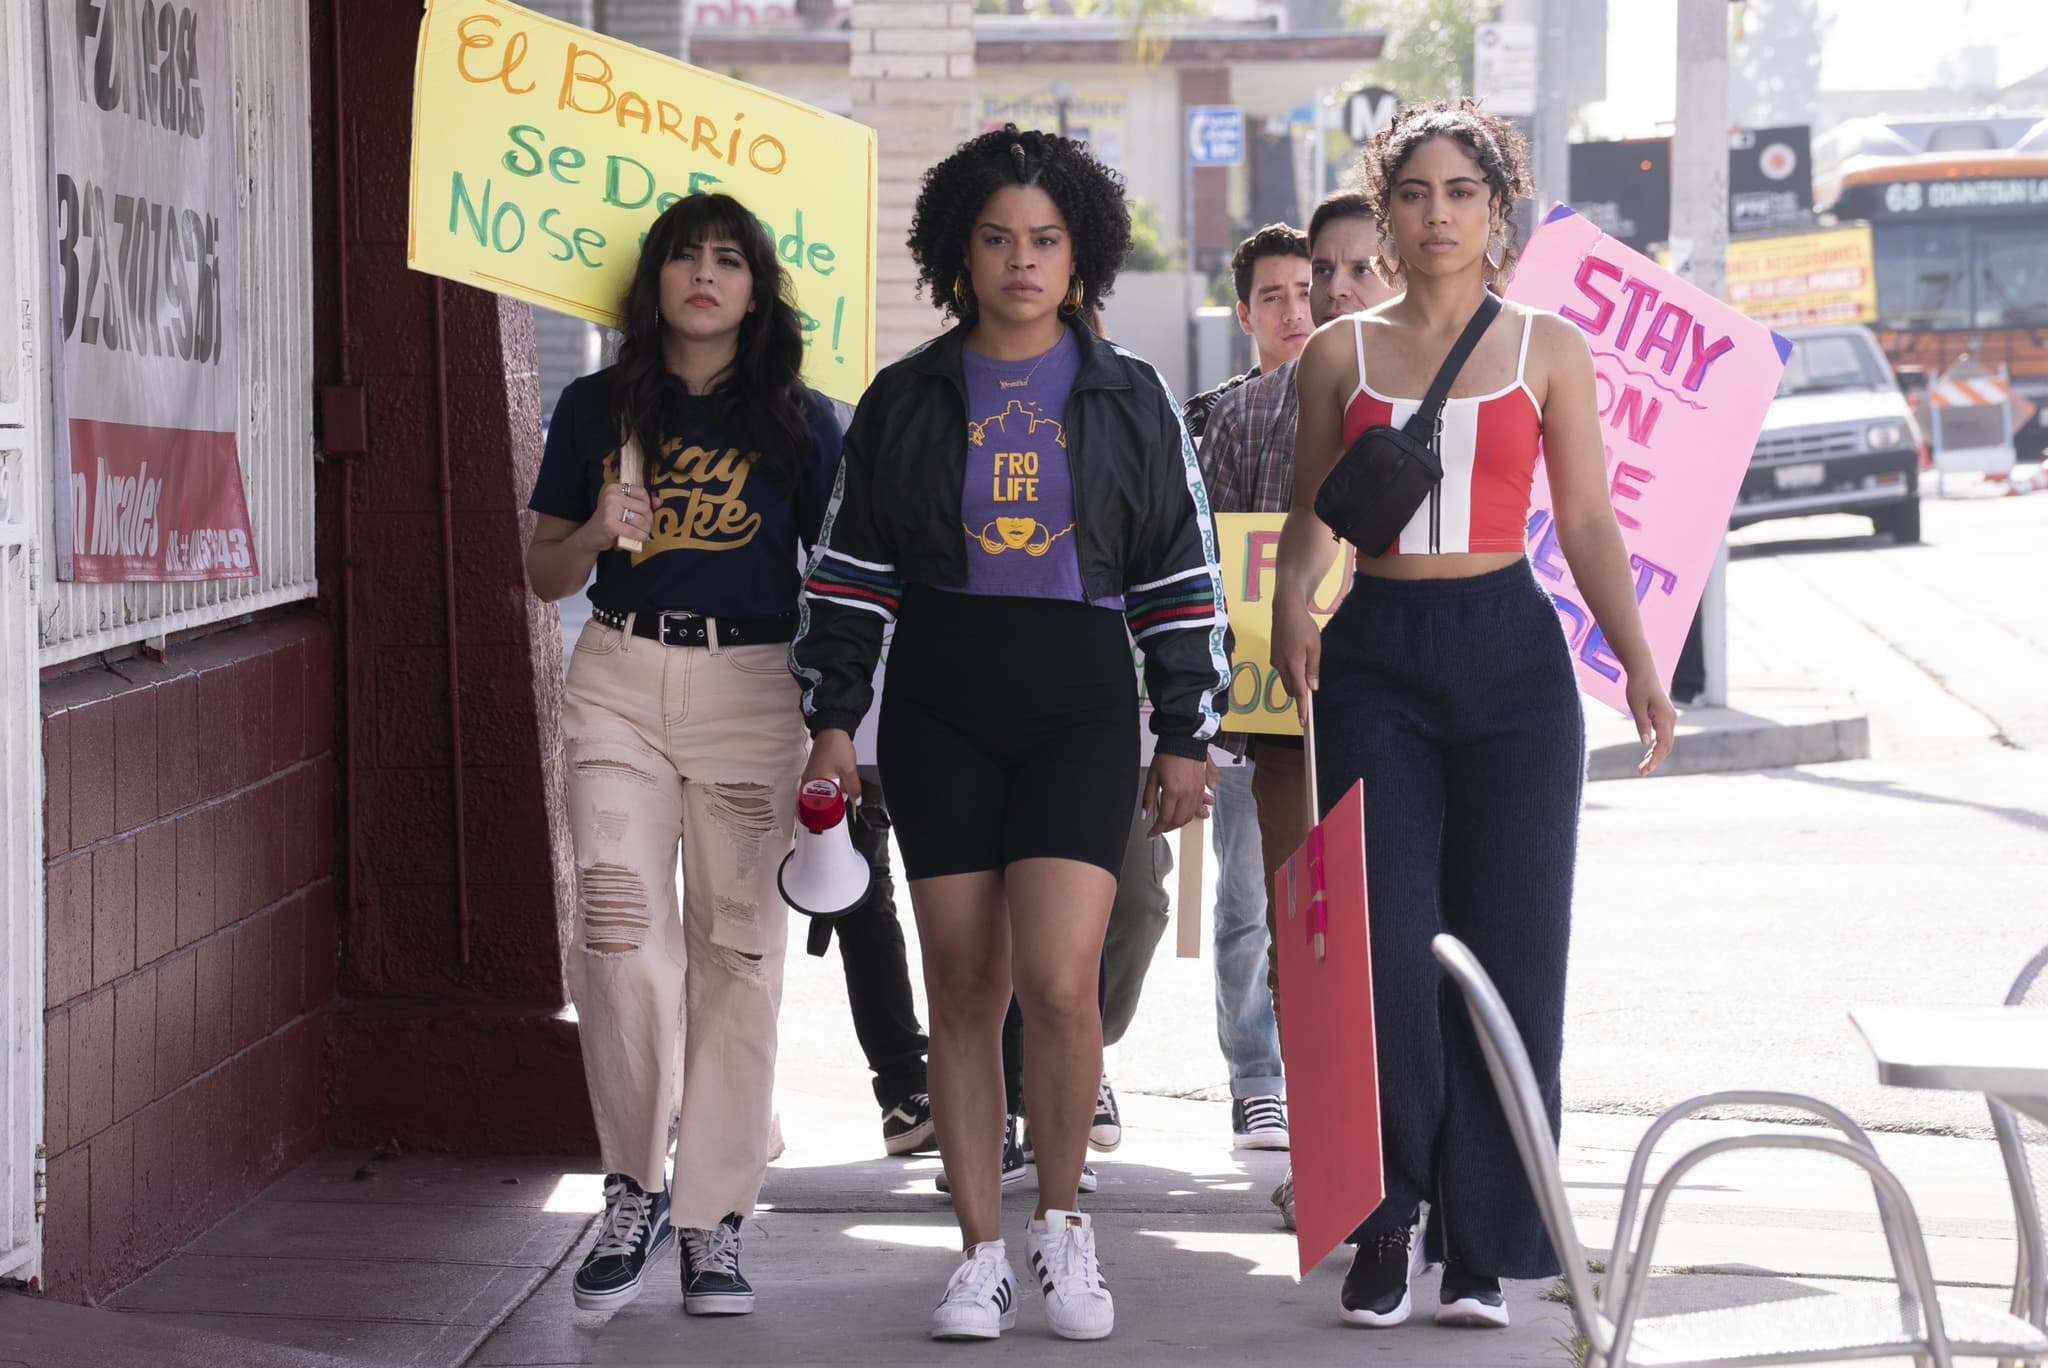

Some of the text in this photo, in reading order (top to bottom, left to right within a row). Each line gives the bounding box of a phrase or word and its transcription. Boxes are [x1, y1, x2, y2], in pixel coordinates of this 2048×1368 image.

[457, 14, 536, 95] El
[501, 124, 586, 184] Se
[538, 208, 606, 268] Se
[1559, 255, 1735, 392] STAY
[993, 451, 1039, 475] FRO
[992, 477, 1039, 501] LIFE
[1190, 479, 1208, 517] PONY
[819, 510, 834, 548] PONY
[1203, 529, 1216, 565] PONY
[1213, 577, 1224, 613] PONY
